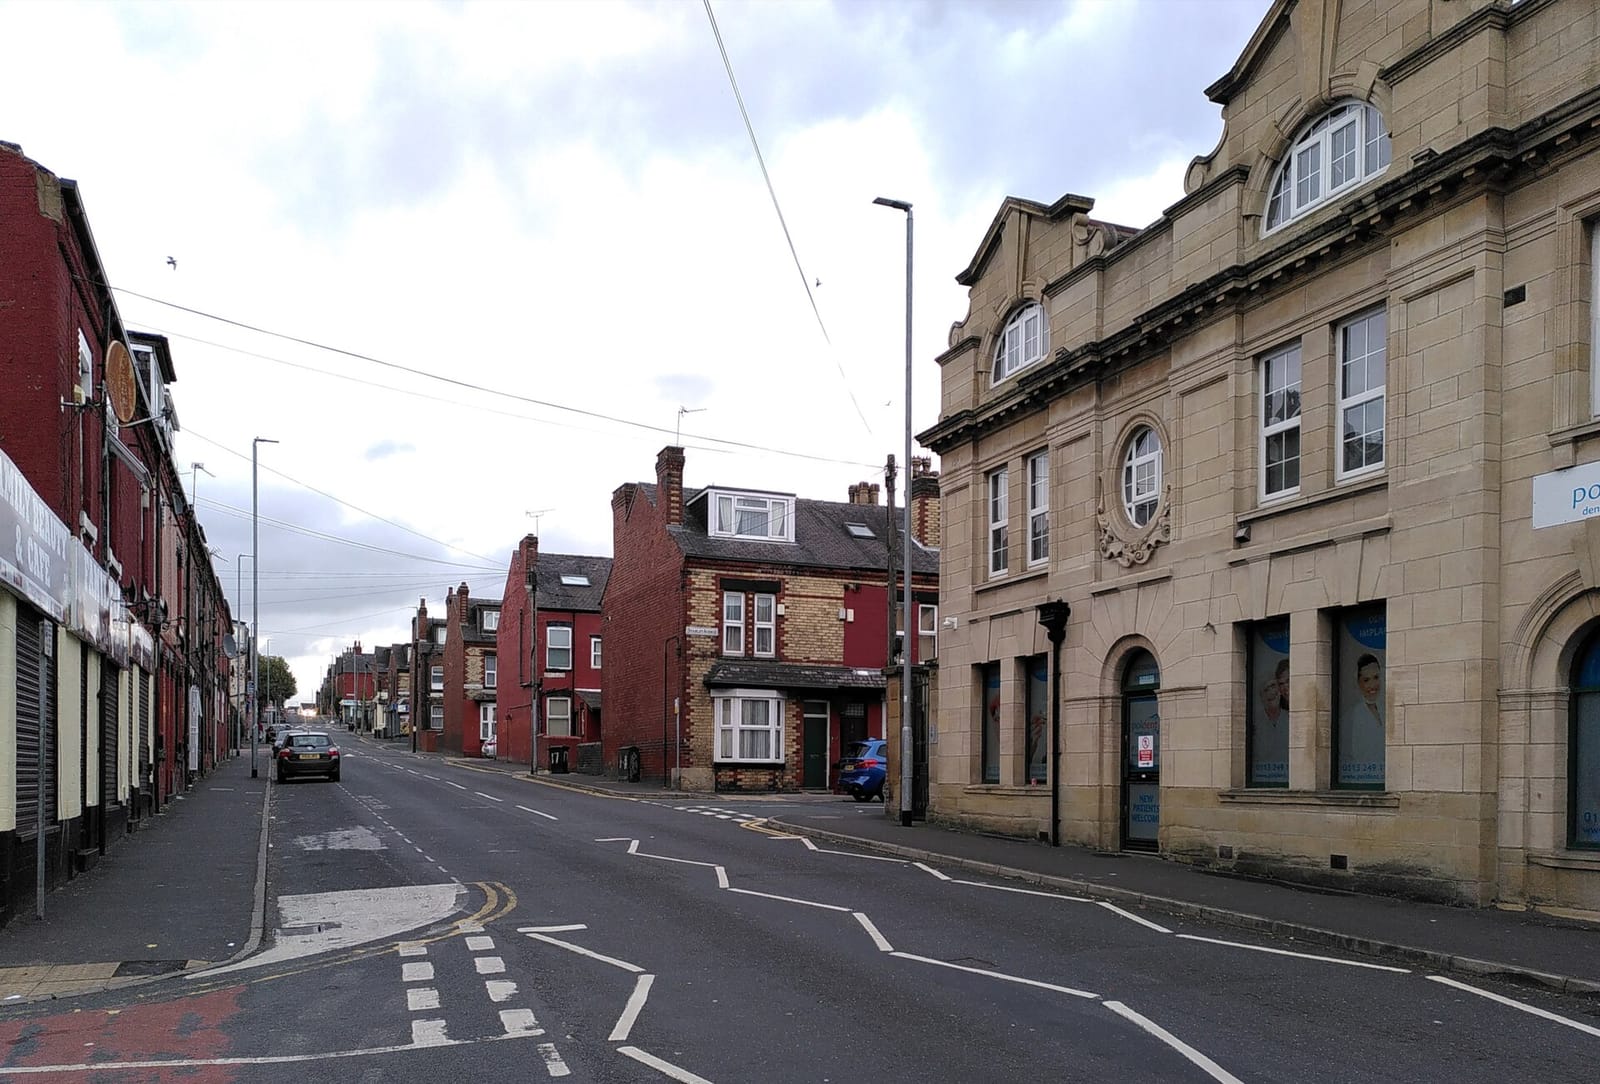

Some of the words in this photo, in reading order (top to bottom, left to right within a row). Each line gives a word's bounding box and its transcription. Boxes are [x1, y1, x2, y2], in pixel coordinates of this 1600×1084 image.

[0, 455, 30, 524] MILY
[32, 496, 69, 561] BEAUTY
[1583, 506, 1600, 515] den
[15, 524, 23, 567] &
